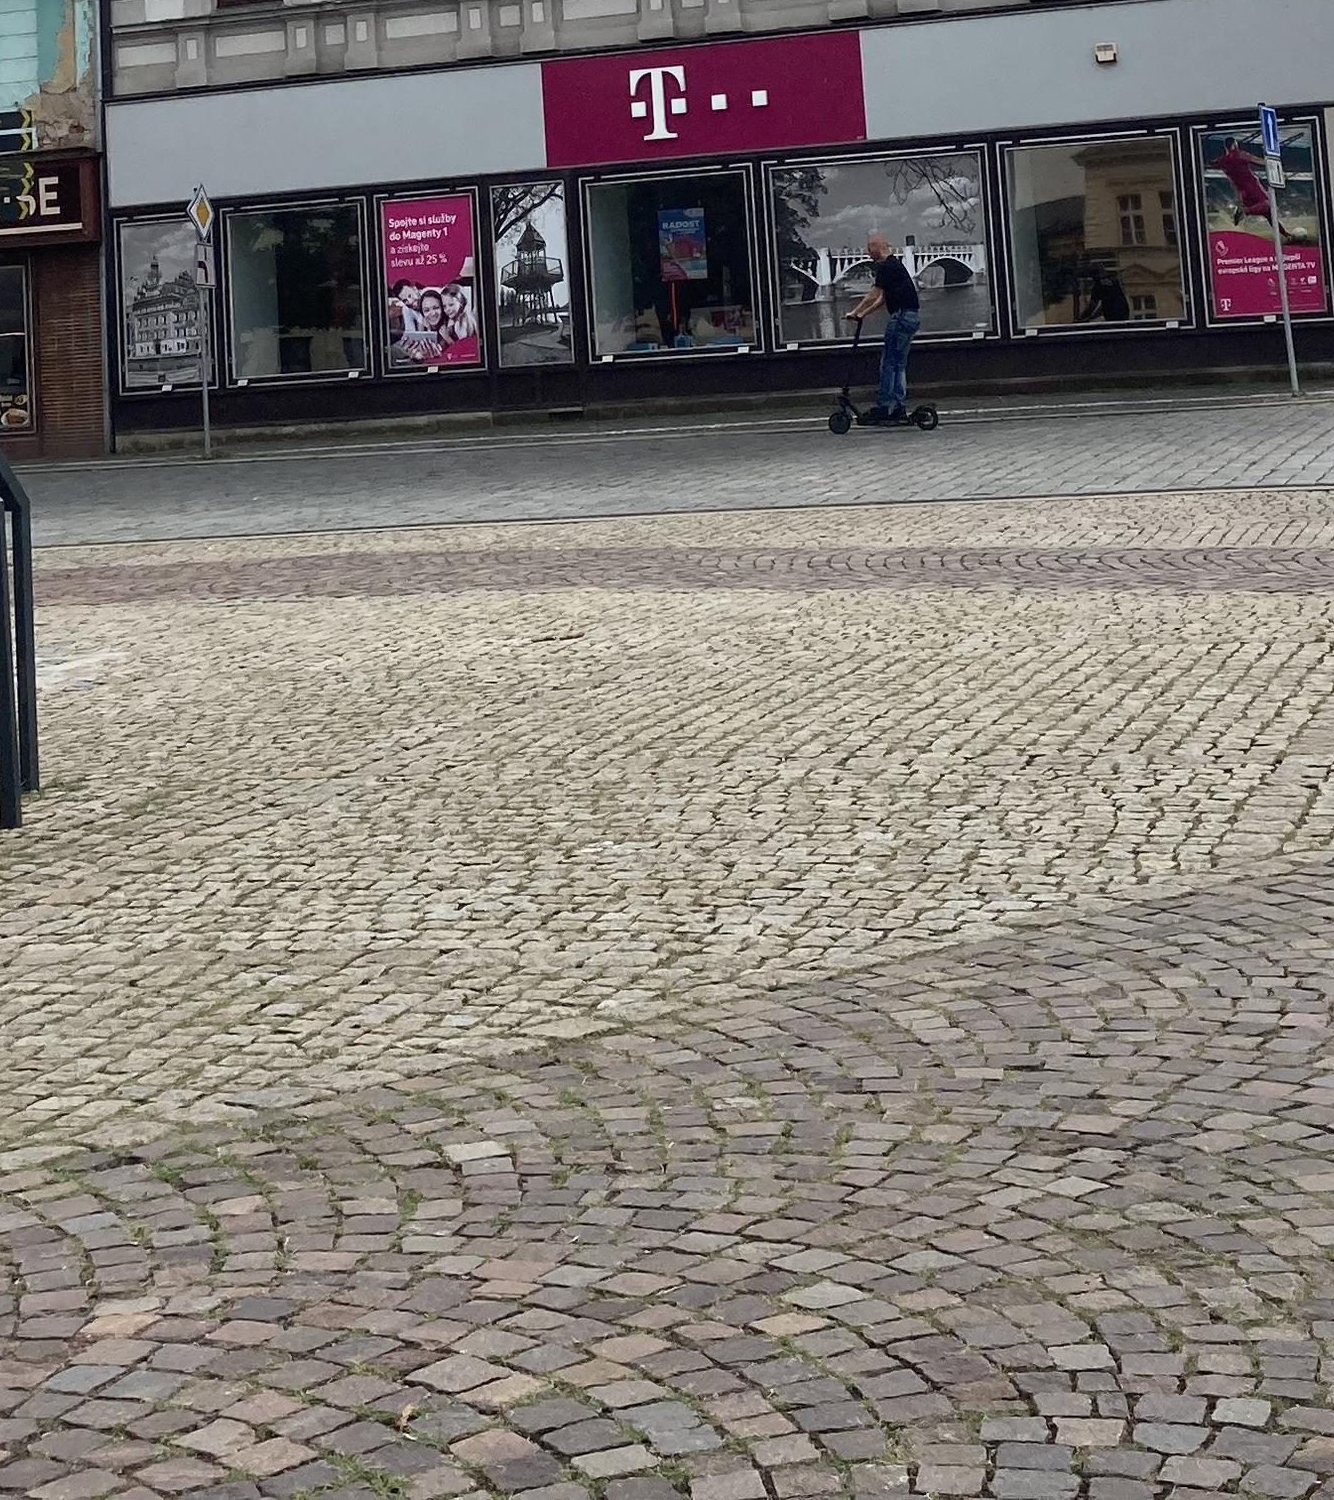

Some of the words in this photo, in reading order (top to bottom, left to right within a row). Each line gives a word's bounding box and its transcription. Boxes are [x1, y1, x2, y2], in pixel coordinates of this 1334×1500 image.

[388, 216, 417, 229] Spojte
[418, 215, 427, 225] si
[662, 219, 700, 230] RADOST
[389, 231, 401, 241] do
[402, 228, 442, 241] Magenty
[442, 227, 448, 236] 1
[390, 257, 414, 268] slevu
[426, 254, 438, 265] 25
[439, 253, 448, 263] %
